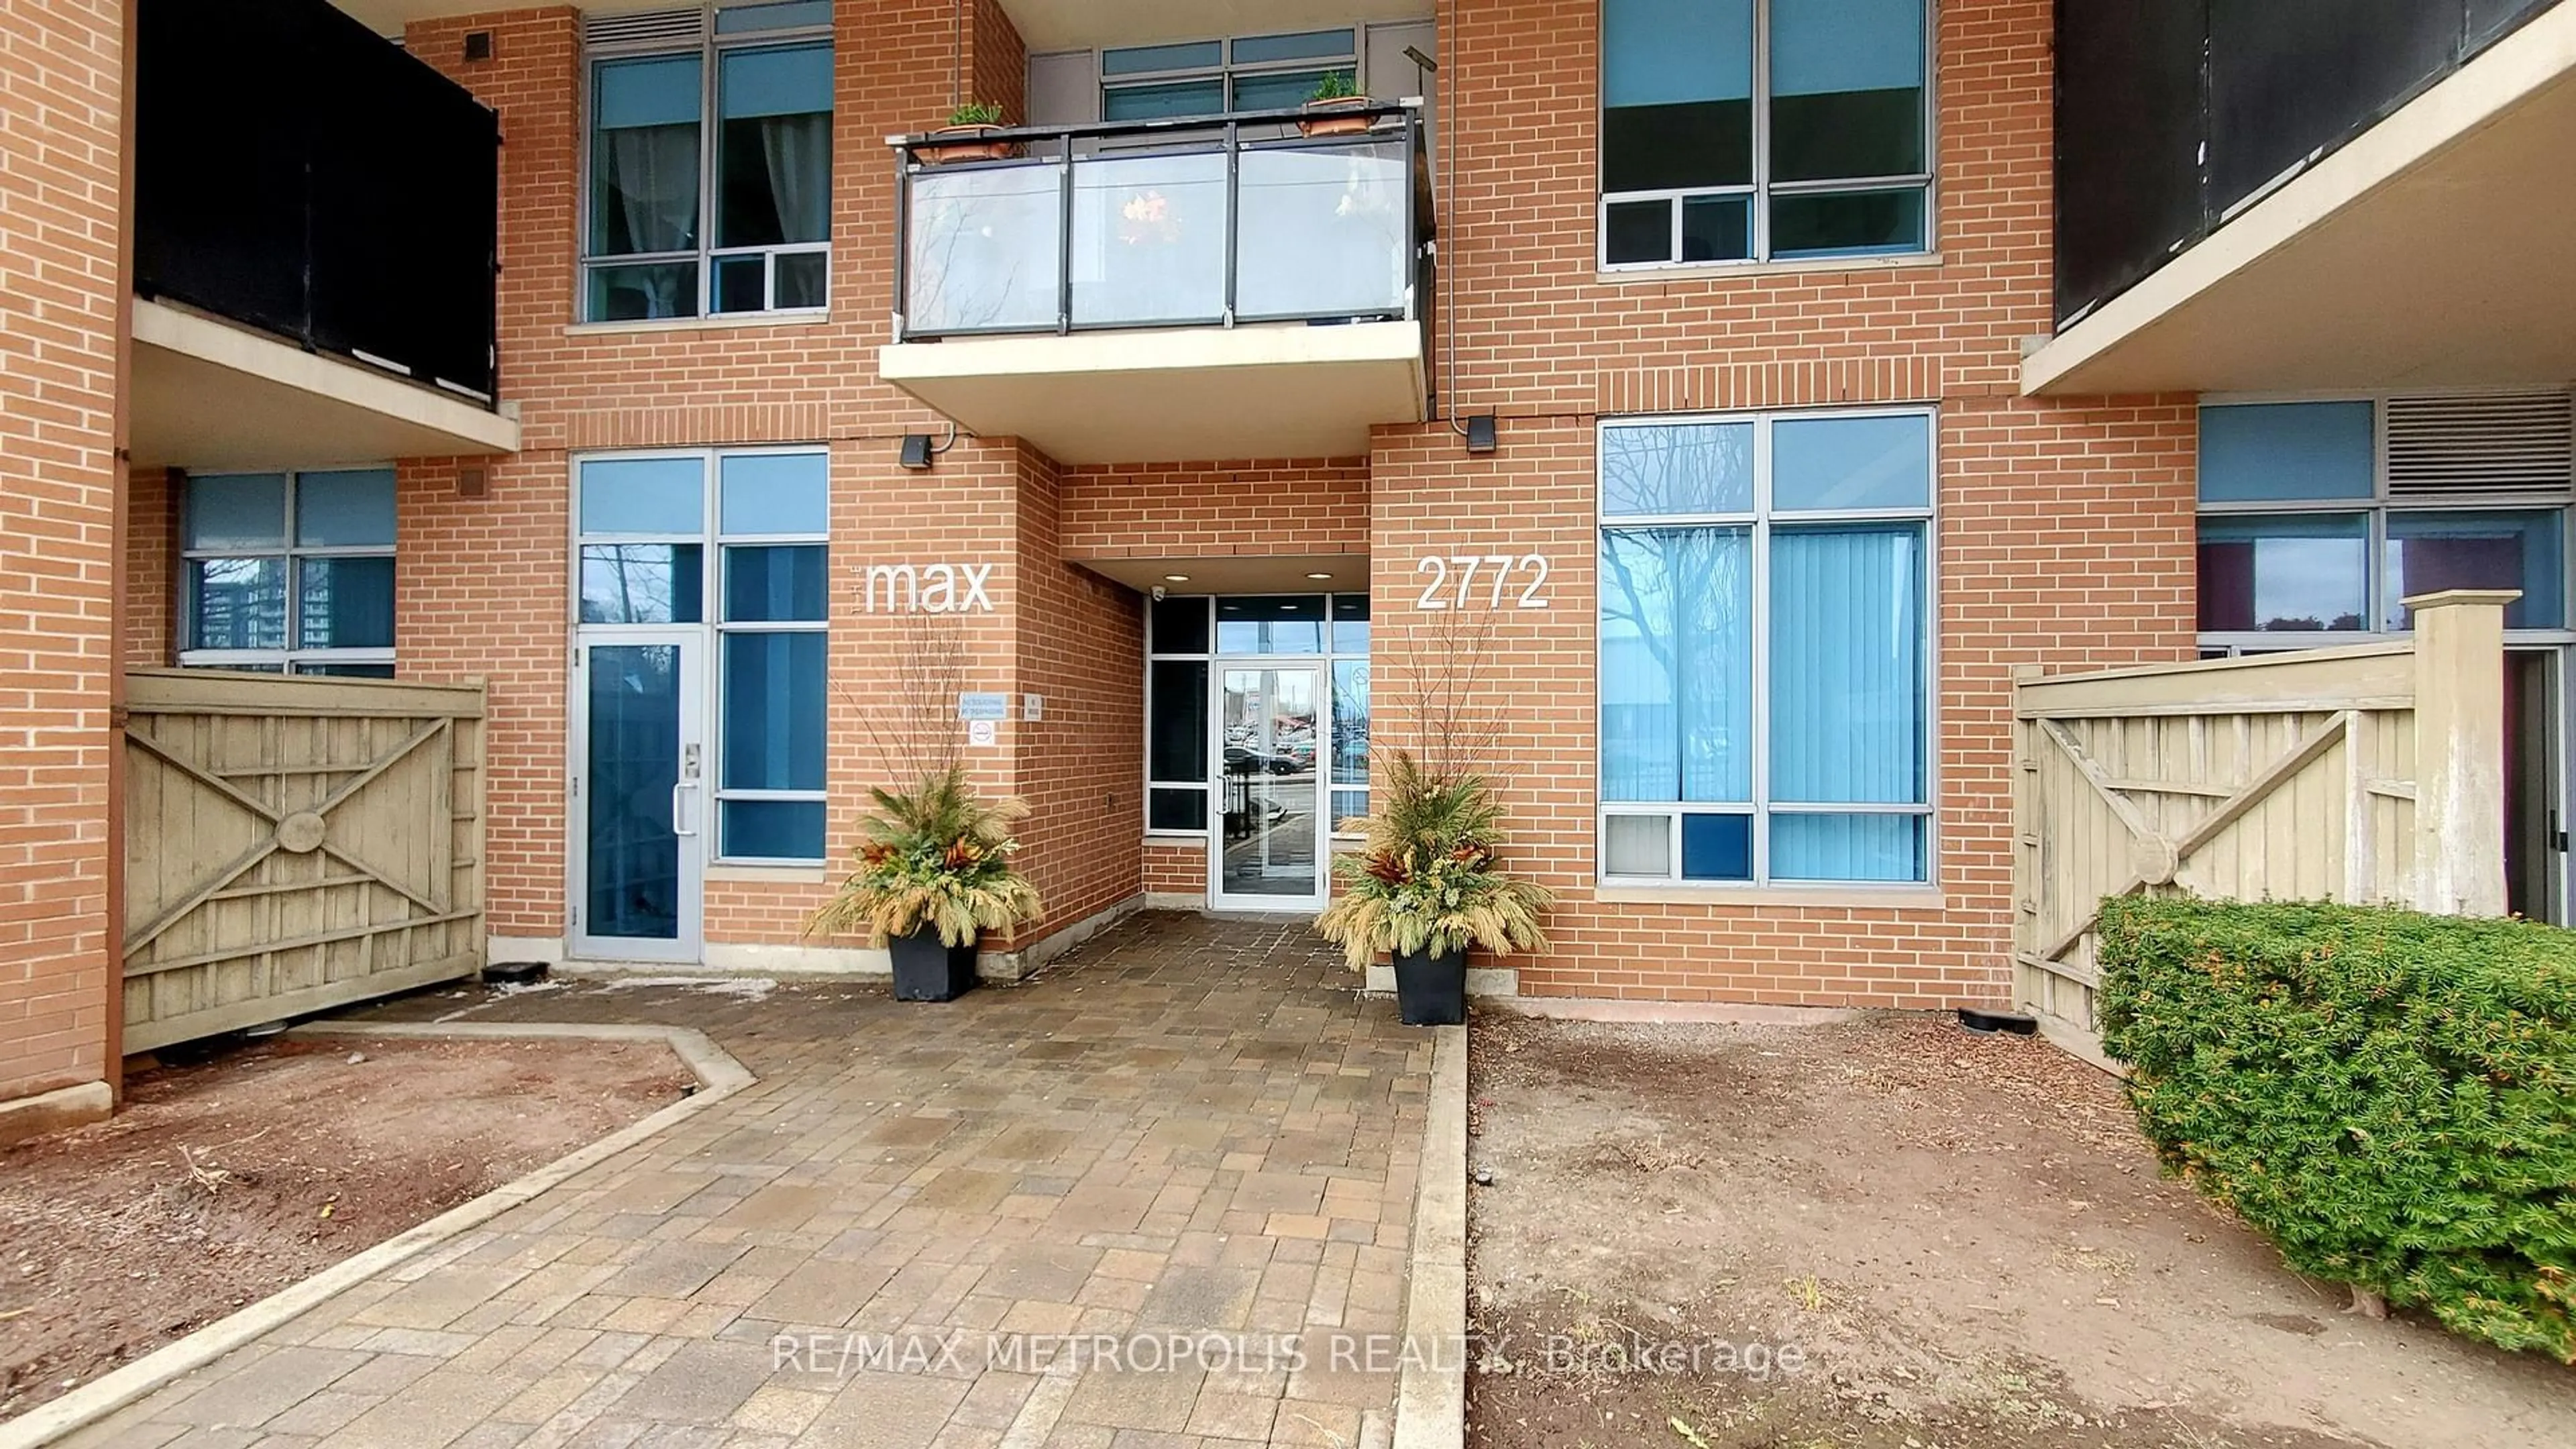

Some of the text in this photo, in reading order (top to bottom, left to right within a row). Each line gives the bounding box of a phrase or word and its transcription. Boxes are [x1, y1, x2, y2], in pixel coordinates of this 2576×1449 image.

[850, 566, 862, 614] THE
[866, 563, 994, 614] max
[1417, 554, 1549, 609] 2772
